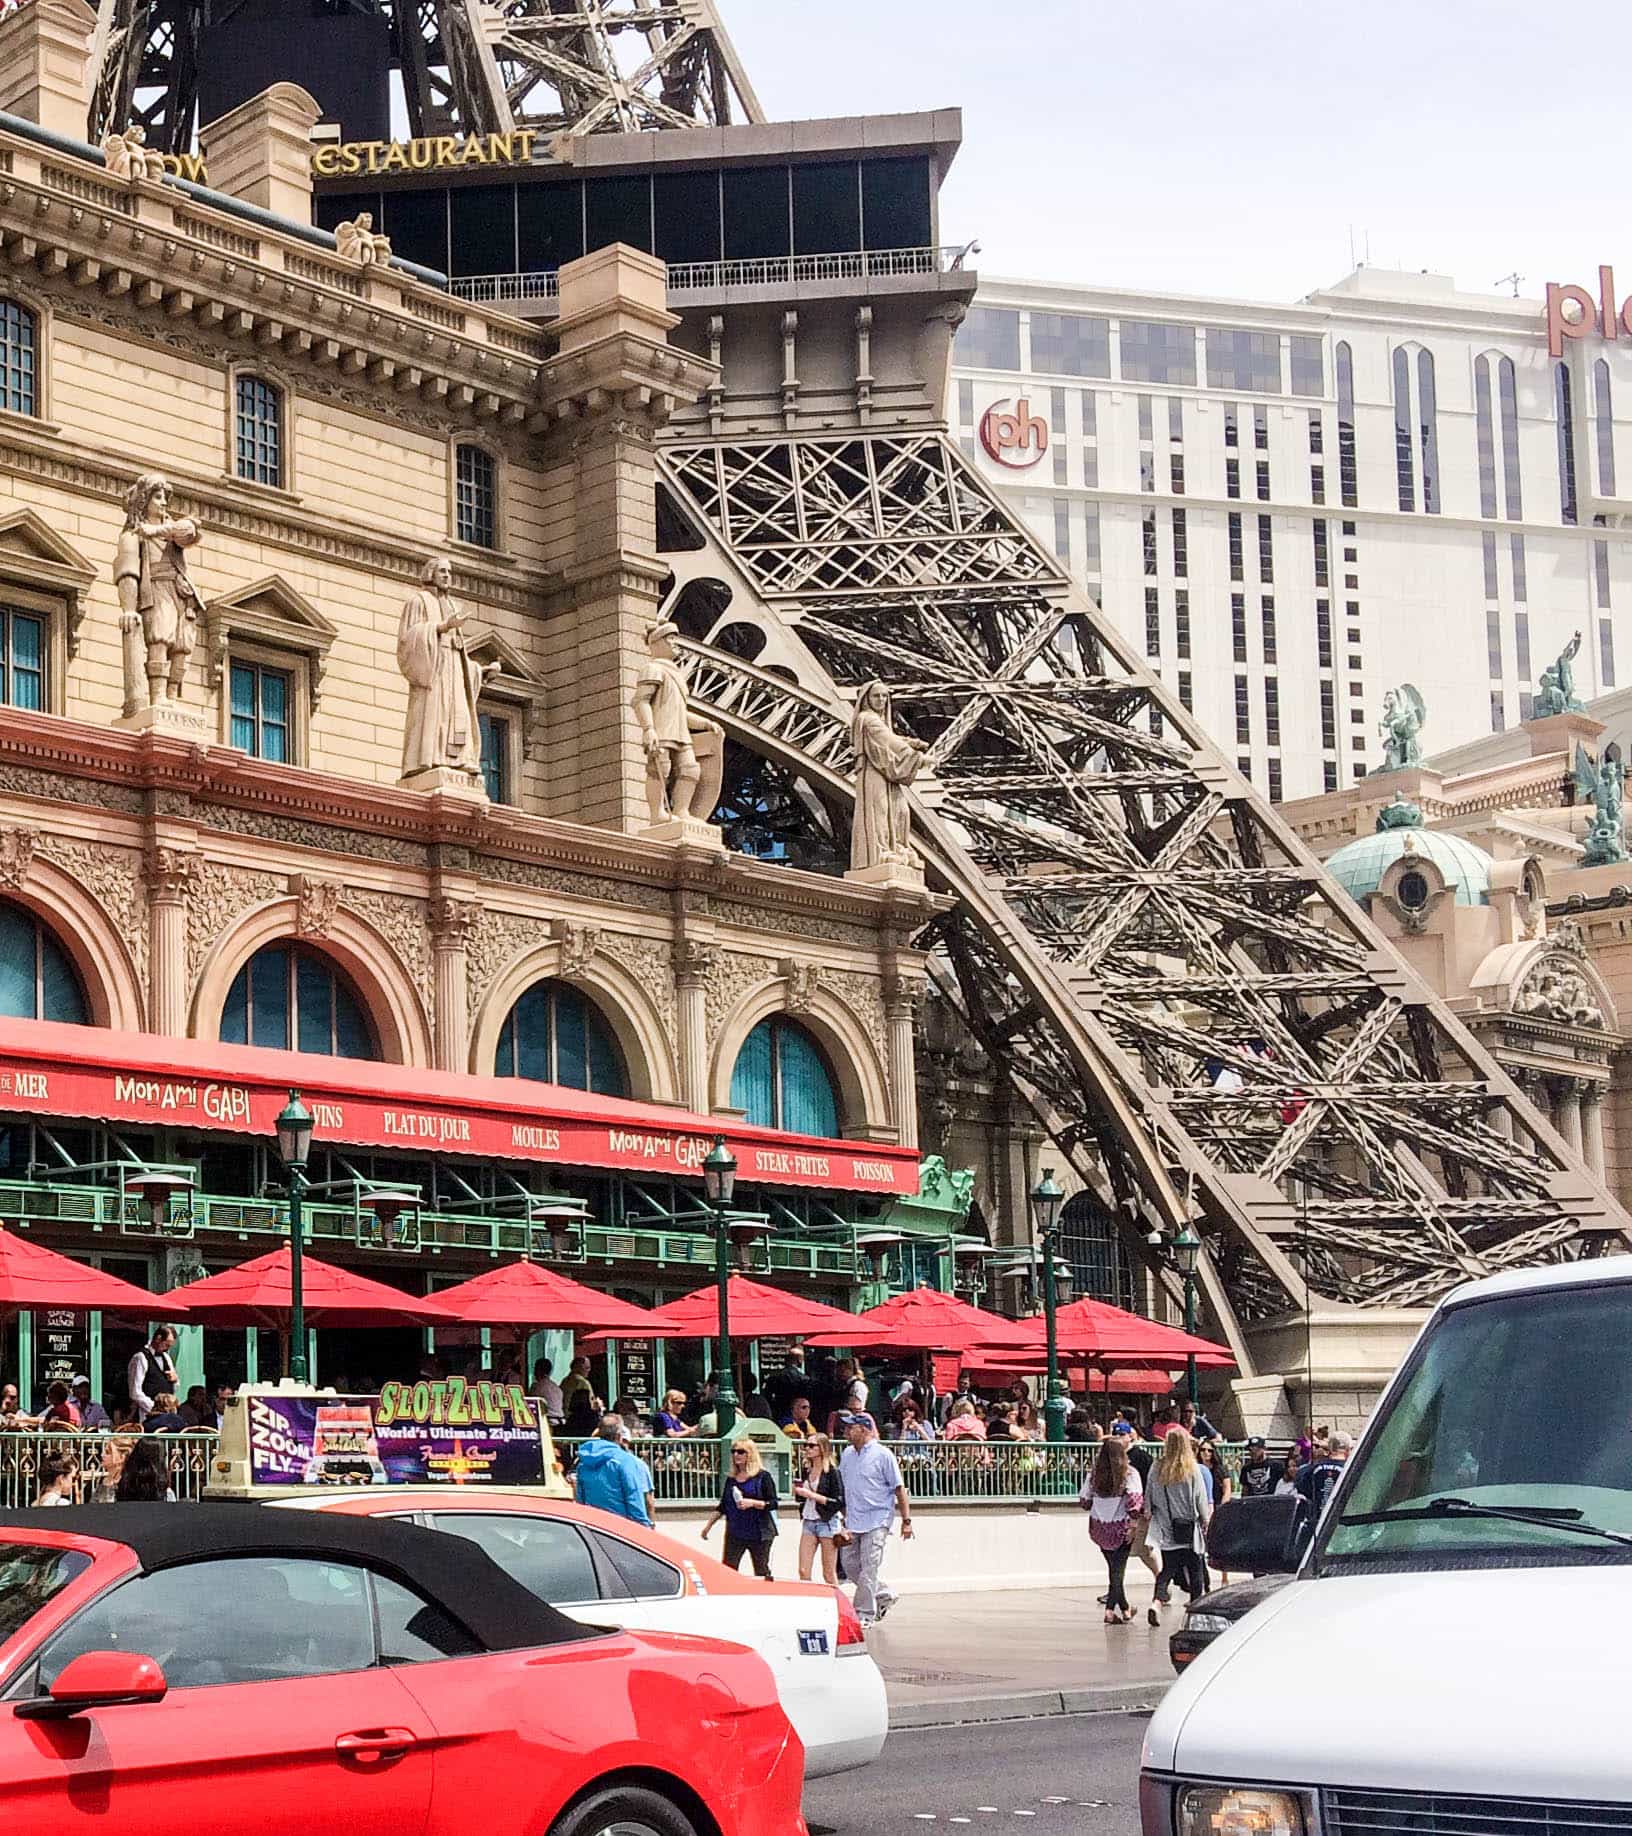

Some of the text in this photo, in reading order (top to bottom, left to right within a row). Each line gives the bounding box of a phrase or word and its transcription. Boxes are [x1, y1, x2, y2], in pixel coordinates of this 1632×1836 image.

[313, 130, 537, 176] ESTAURANT
[1546, 265, 1632, 358] pl
[988, 399, 1048, 457] ph
[14, 1072, 49, 1099] MER
[115, 1075, 251, 1124] Mon Ami GABI
[311, 1104, 343, 1129] VINS
[383, 1111, 471, 1143] PLAT DU JOUR
[511, 1125, 560, 1151] MOULES
[608, 1129, 643, 1154] Mon
[643, 1132, 671, 1158] Ami
[853, 1160, 894, 1183] POISSON
[375, 1427, 539, 1442] World's Ultimate Zipline
